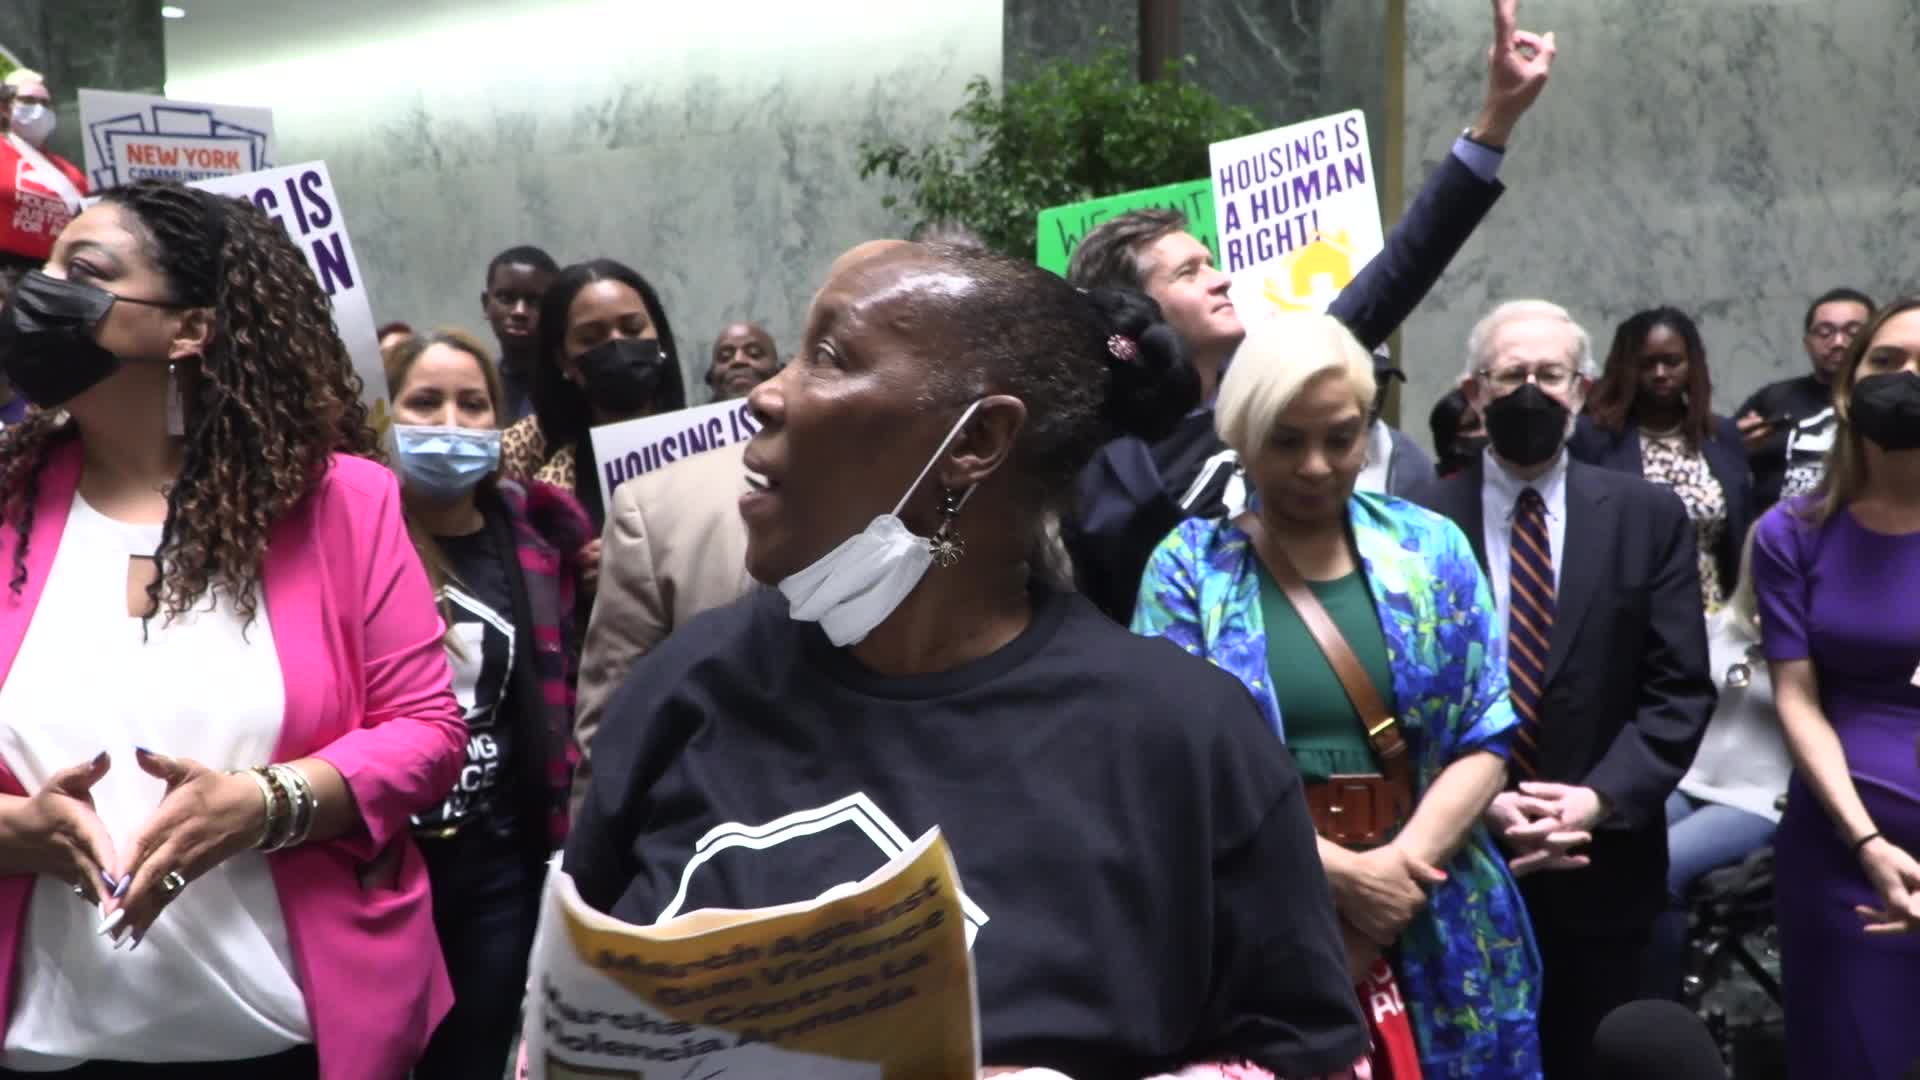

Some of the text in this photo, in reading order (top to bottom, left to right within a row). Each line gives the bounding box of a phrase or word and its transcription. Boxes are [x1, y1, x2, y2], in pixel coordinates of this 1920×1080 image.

[126, 143, 241, 170] NEW YORK
[1219, 116, 1360, 197] HOUSING IS
[1225, 152, 1366, 234] A HUMAN
[285, 170, 332, 235] IS
[1227, 209, 1320, 273] RIGHT!
[595, 876, 940, 979] March Against
[655, 910, 945, 1006] Gun Violence
[703, 973, 875, 1026] Contra
[881, 952, 930, 981] La
[734, 984, 919, 1048] Armada
